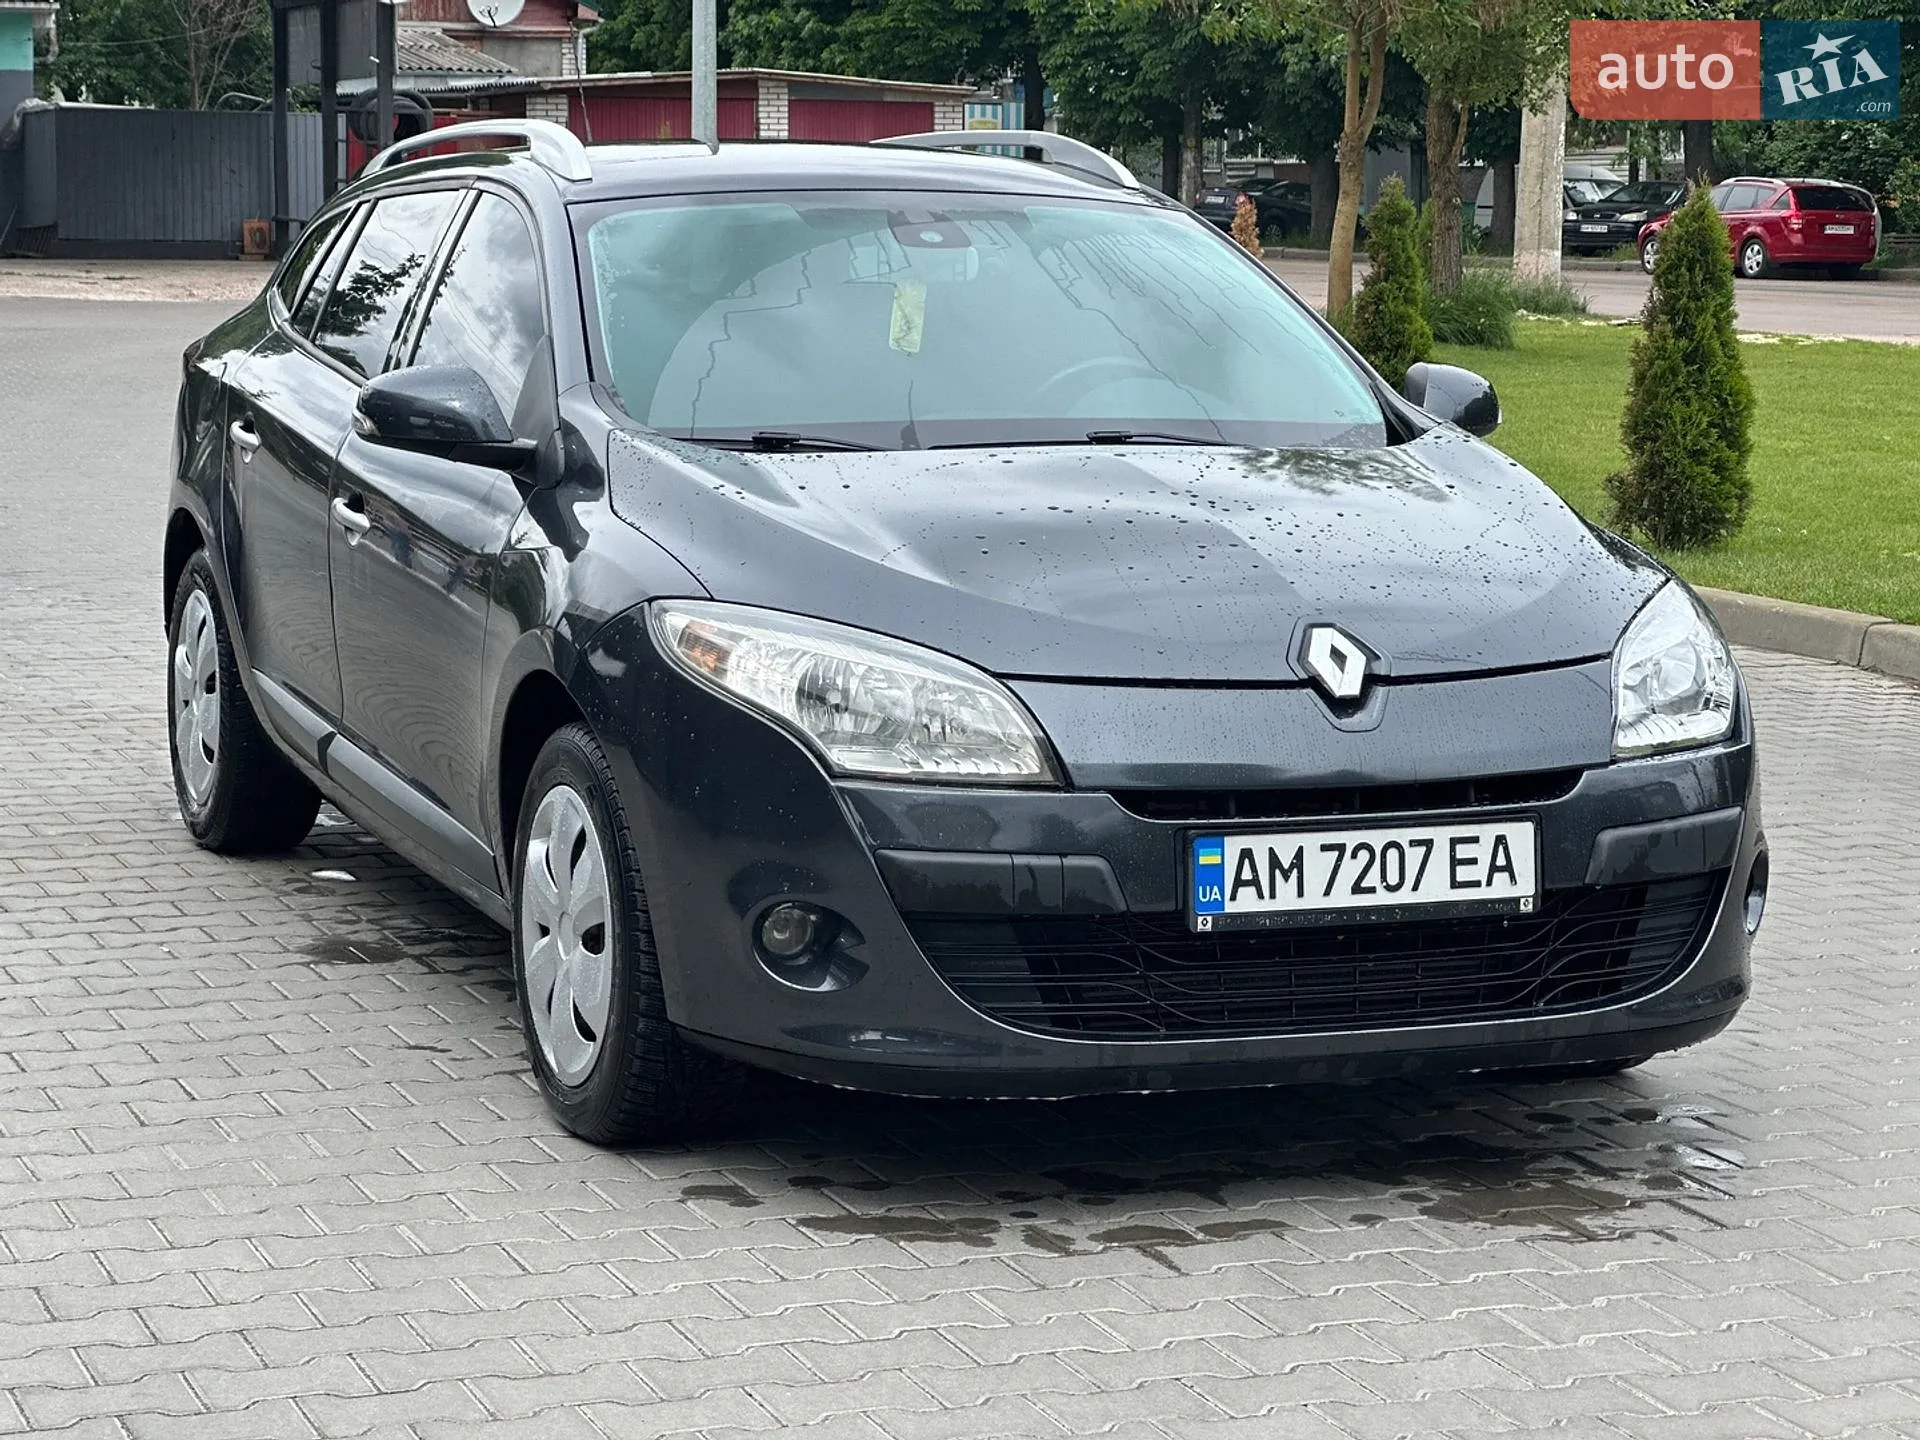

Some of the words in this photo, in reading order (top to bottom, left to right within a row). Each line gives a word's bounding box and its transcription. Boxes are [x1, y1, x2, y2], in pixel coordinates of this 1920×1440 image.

[1229, 844, 1304, 902] AM
[1319, 837, 1435, 897] 7207
[1449, 833, 1518, 890] EA
[1198, 885, 1222, 902] UA
